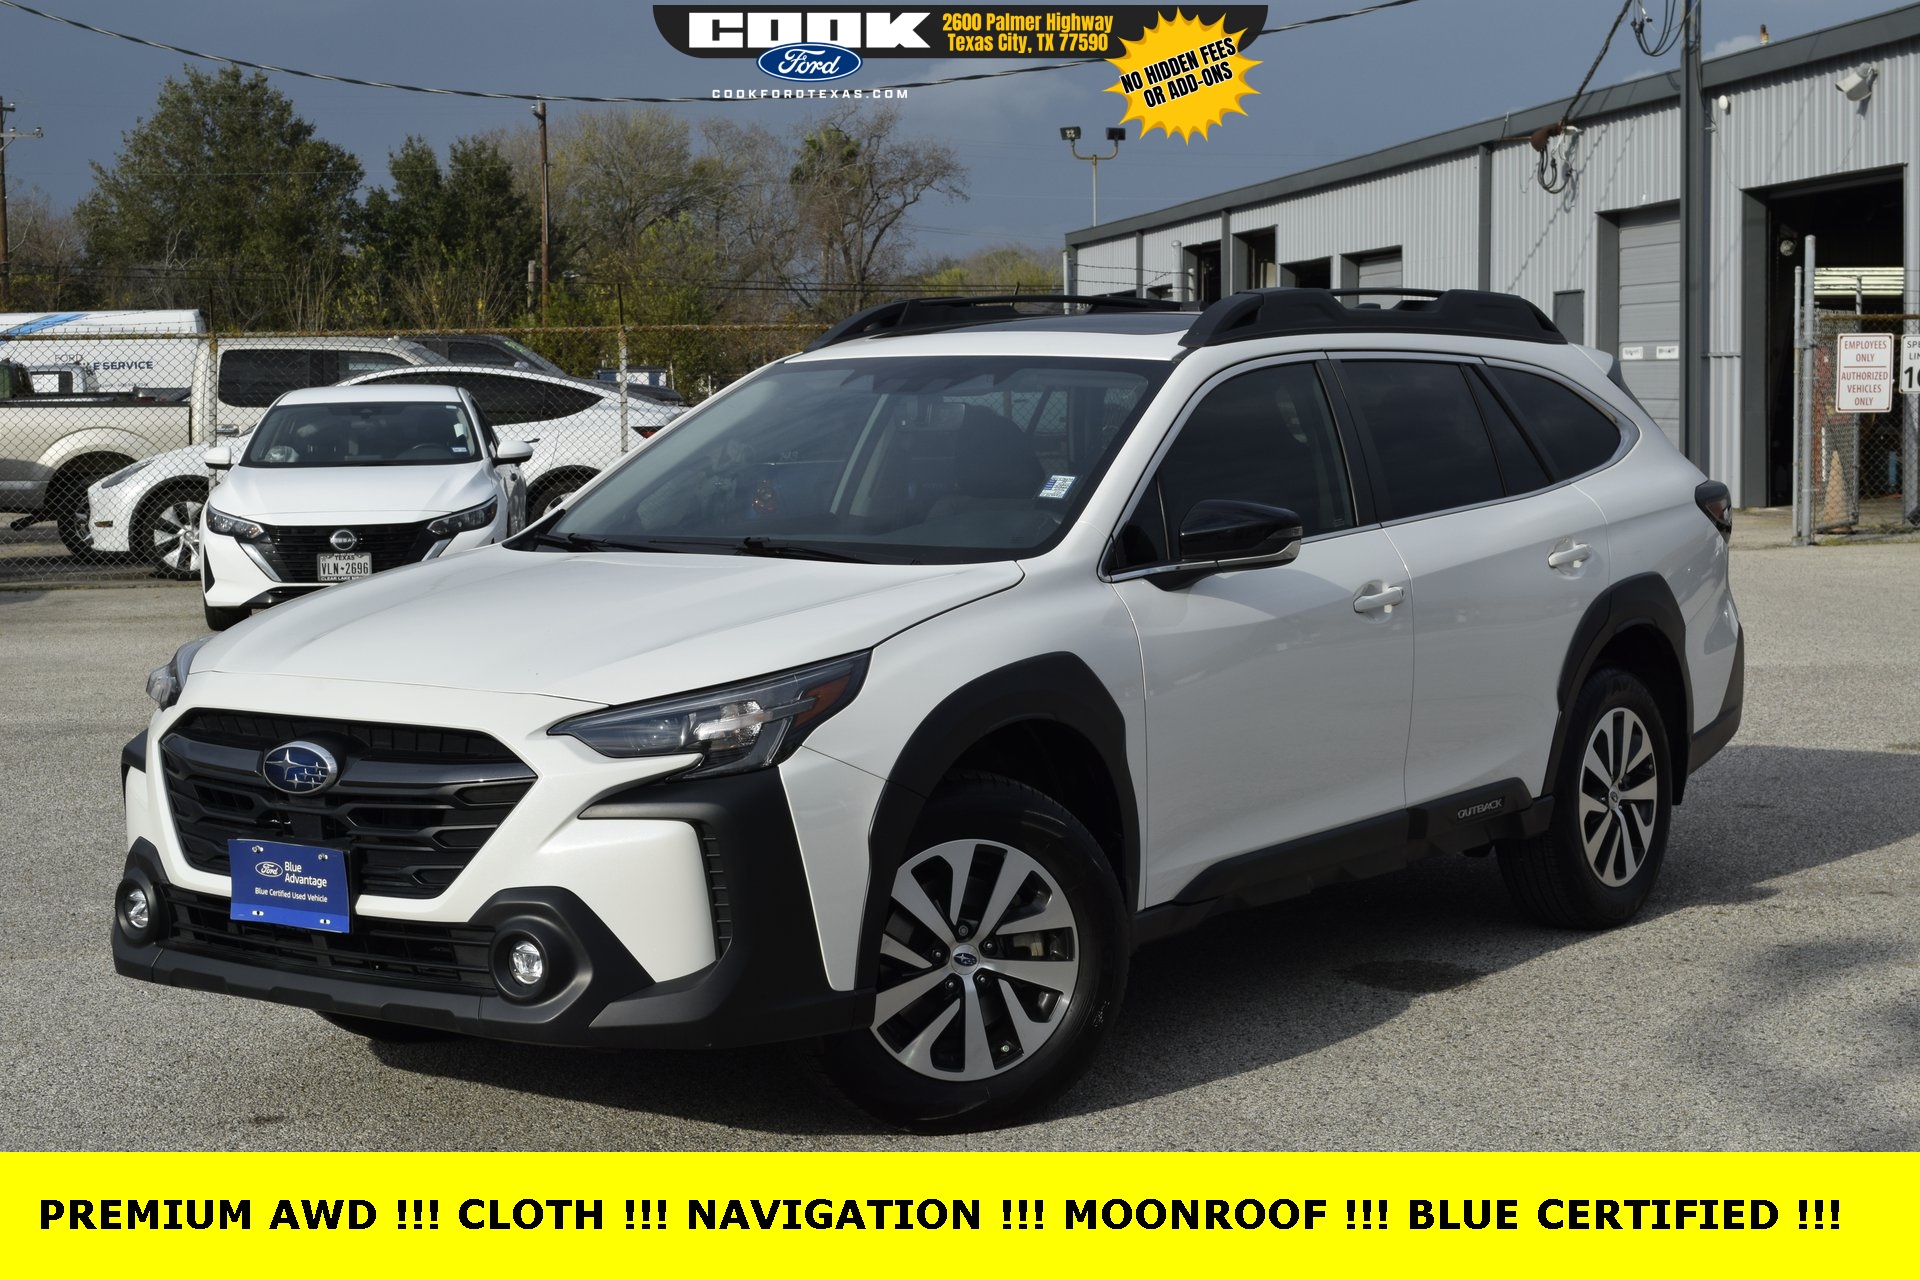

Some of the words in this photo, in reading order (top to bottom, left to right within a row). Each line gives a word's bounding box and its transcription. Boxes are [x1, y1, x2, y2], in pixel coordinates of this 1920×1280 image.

[1844, 340, 1887, 349] EMPLOYEES
[1855, 353, 1875, 362] ONLY
[102, 361, 154, 370] SERVICE
[1841, 371, 1889, 381] AUTHORIZED
[1847, 384, 1882, 393] VEHICLES
[1854, 397, 1874, 406] ONLY
[1457, 798, 1503, 819] OUTBACK
[260, 863, 279, 875] Ford
[284, 861, 302, 873] Blue
[284, 873, 328, 888] Advantage
[255, 887, 269, 896] Blue
[269, 888, 291, 899] Certified
[291, 892, 306, 900] Used
[307, 894, 328, 903] Vehicle
